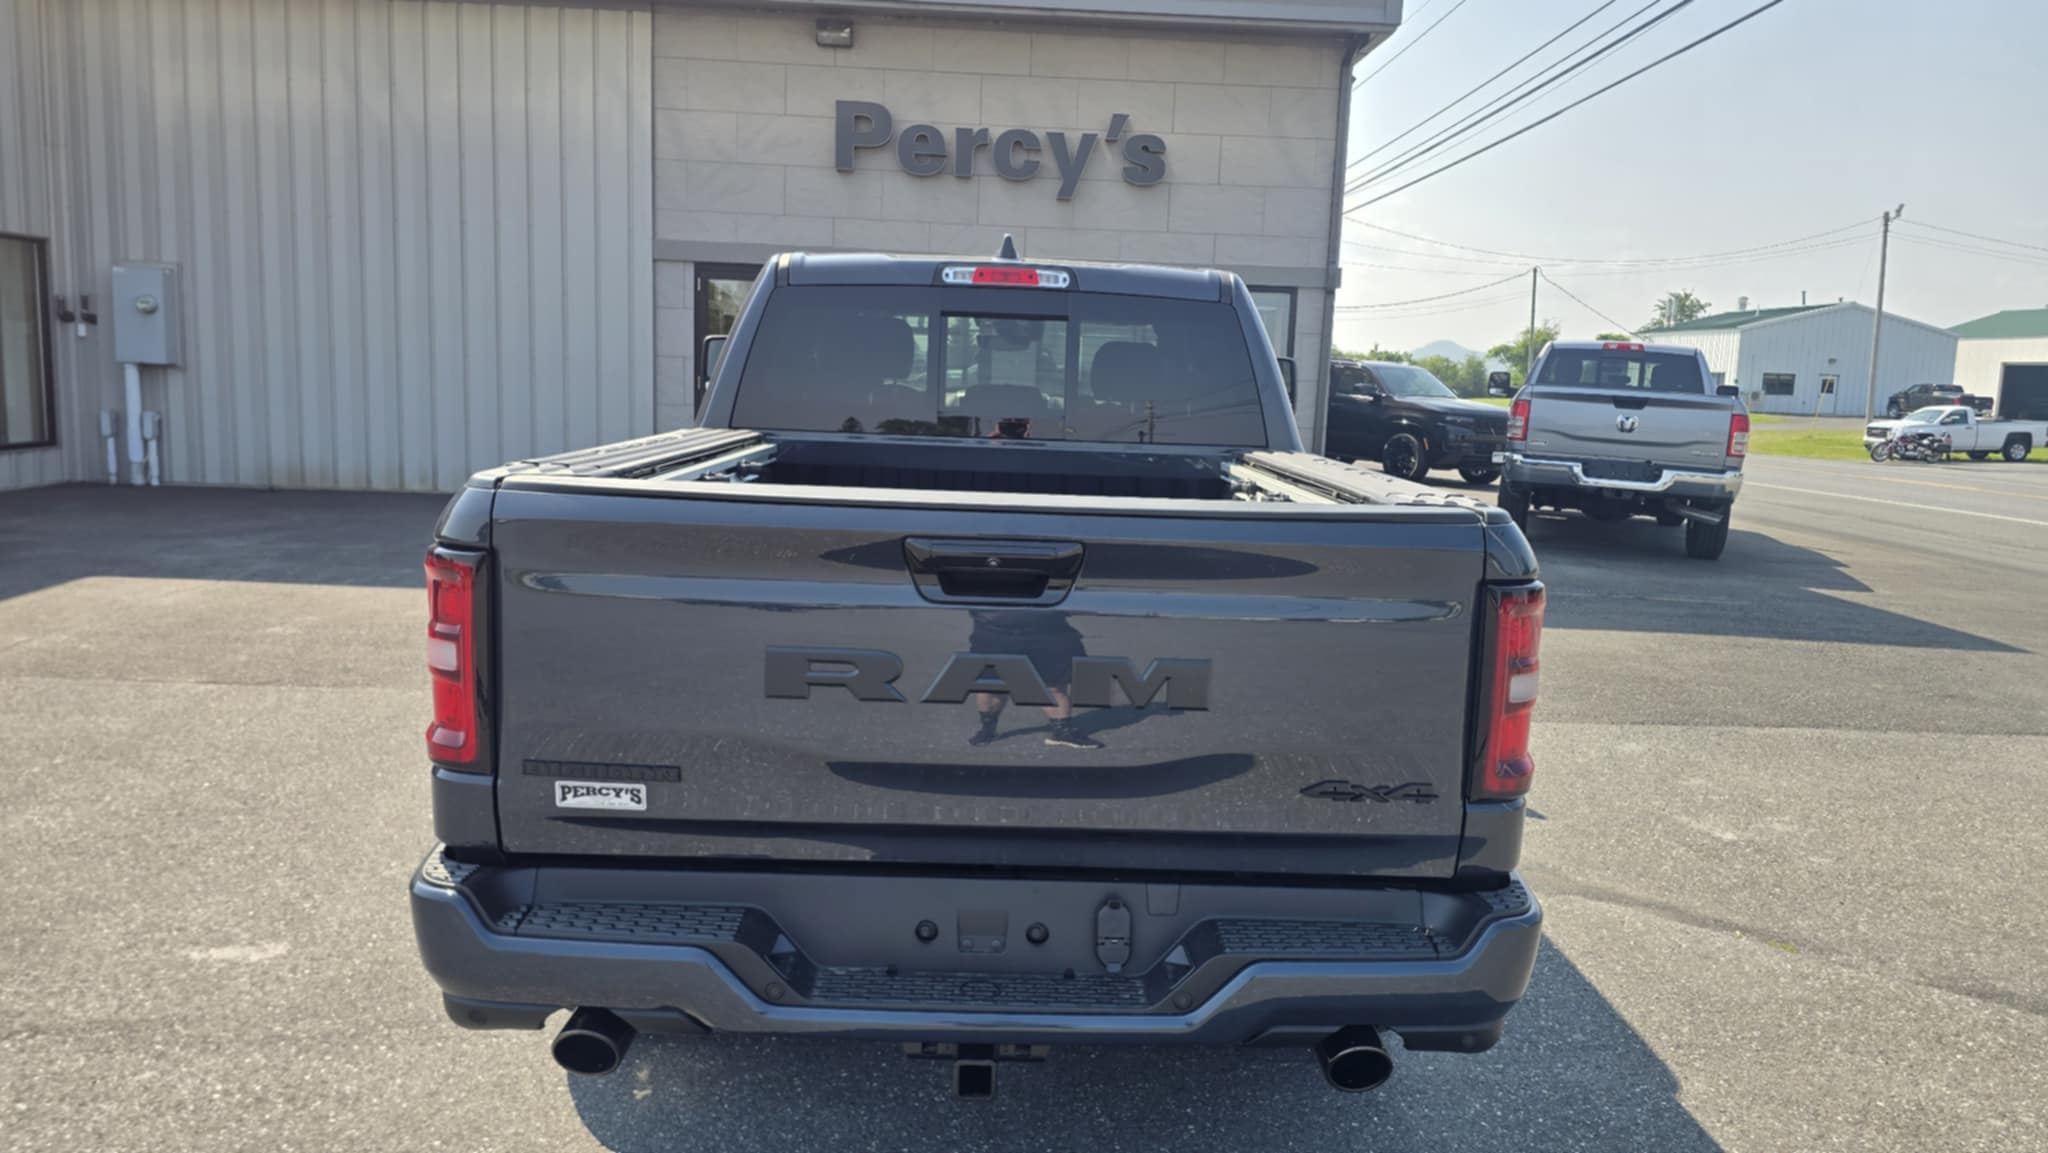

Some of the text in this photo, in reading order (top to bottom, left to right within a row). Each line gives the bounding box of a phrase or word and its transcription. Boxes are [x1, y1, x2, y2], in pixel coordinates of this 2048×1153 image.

[835, 99, 1167, 201] Percy's
[765, 645, 1213, 711] RAM
[559, 784, 643, 805] PERCY'S
